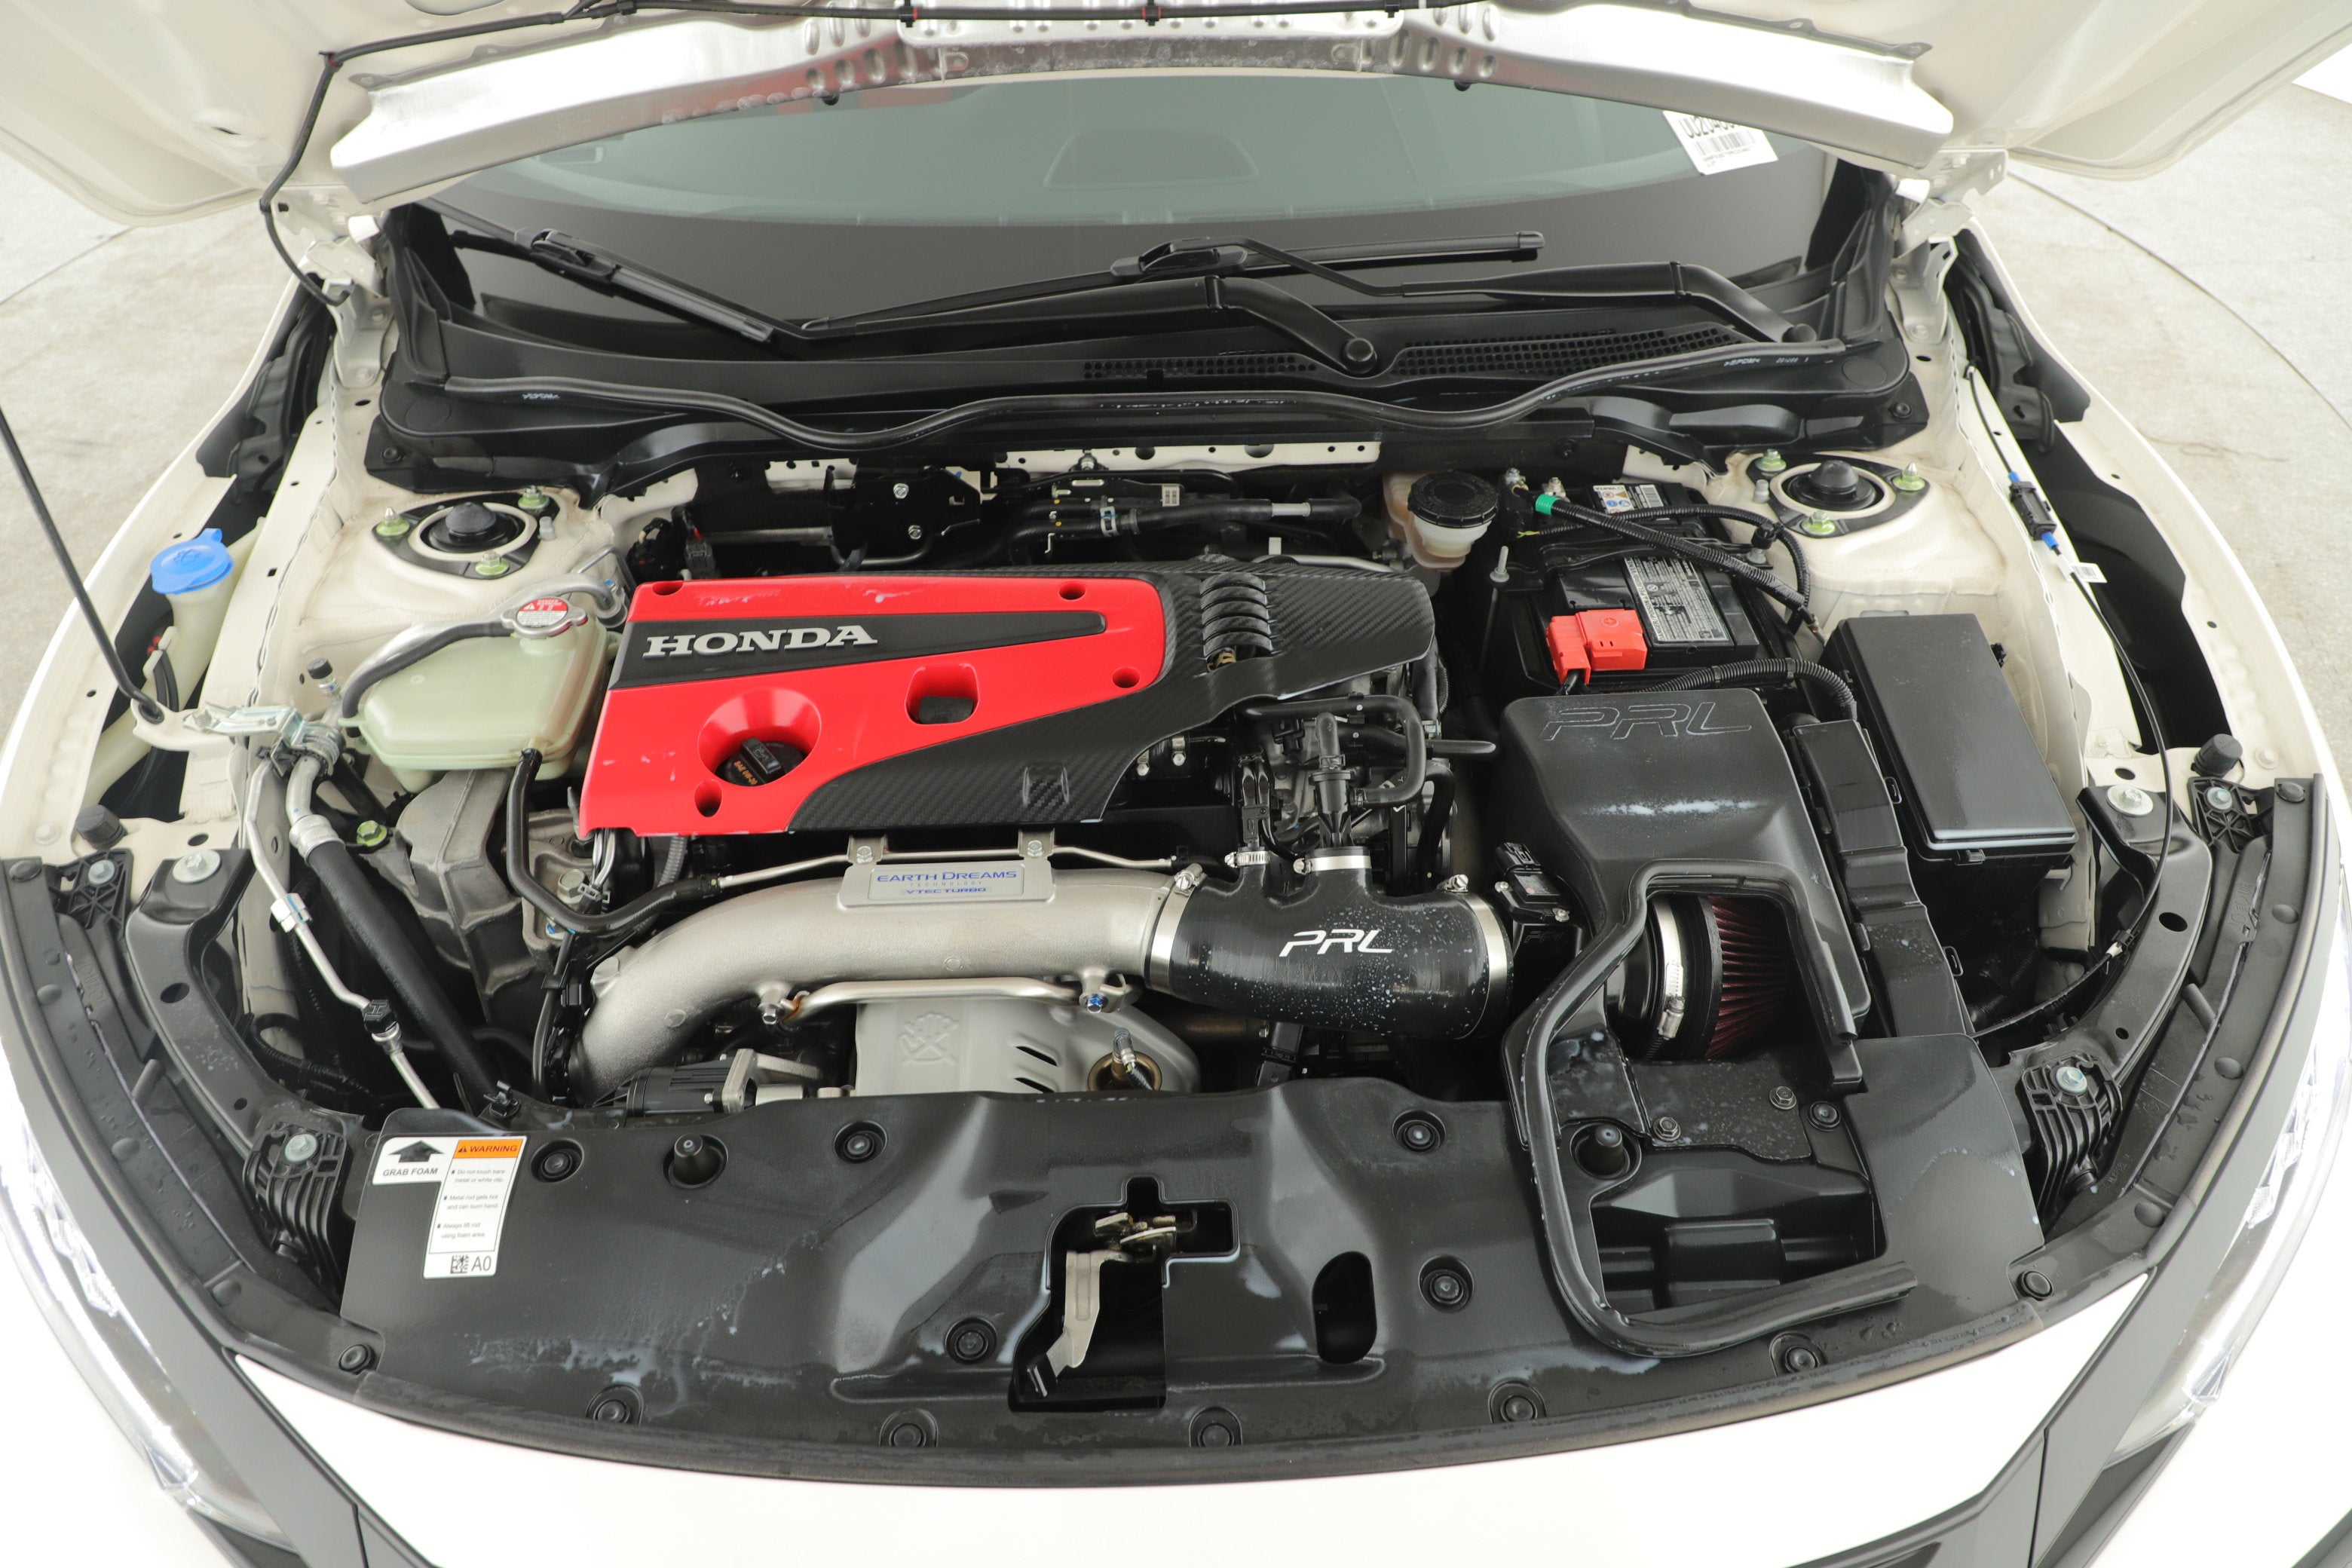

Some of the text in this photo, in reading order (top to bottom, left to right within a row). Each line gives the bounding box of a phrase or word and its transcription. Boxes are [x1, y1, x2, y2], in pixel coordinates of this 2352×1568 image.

[642, 624, 877, 659] HONDA
[1539, 702, 1752, 741] PRL
[733, 761, 746, 771] SAE
[877, 871, 1017, 882] EARTH DREAMS
[1279, 929, 1393, 957] PRL
[470, 1144, 518, 1153] WARNING
[382, 1167, 438, 1177] GRAB FOAM
[471, 1256, 492, 1272] A0
